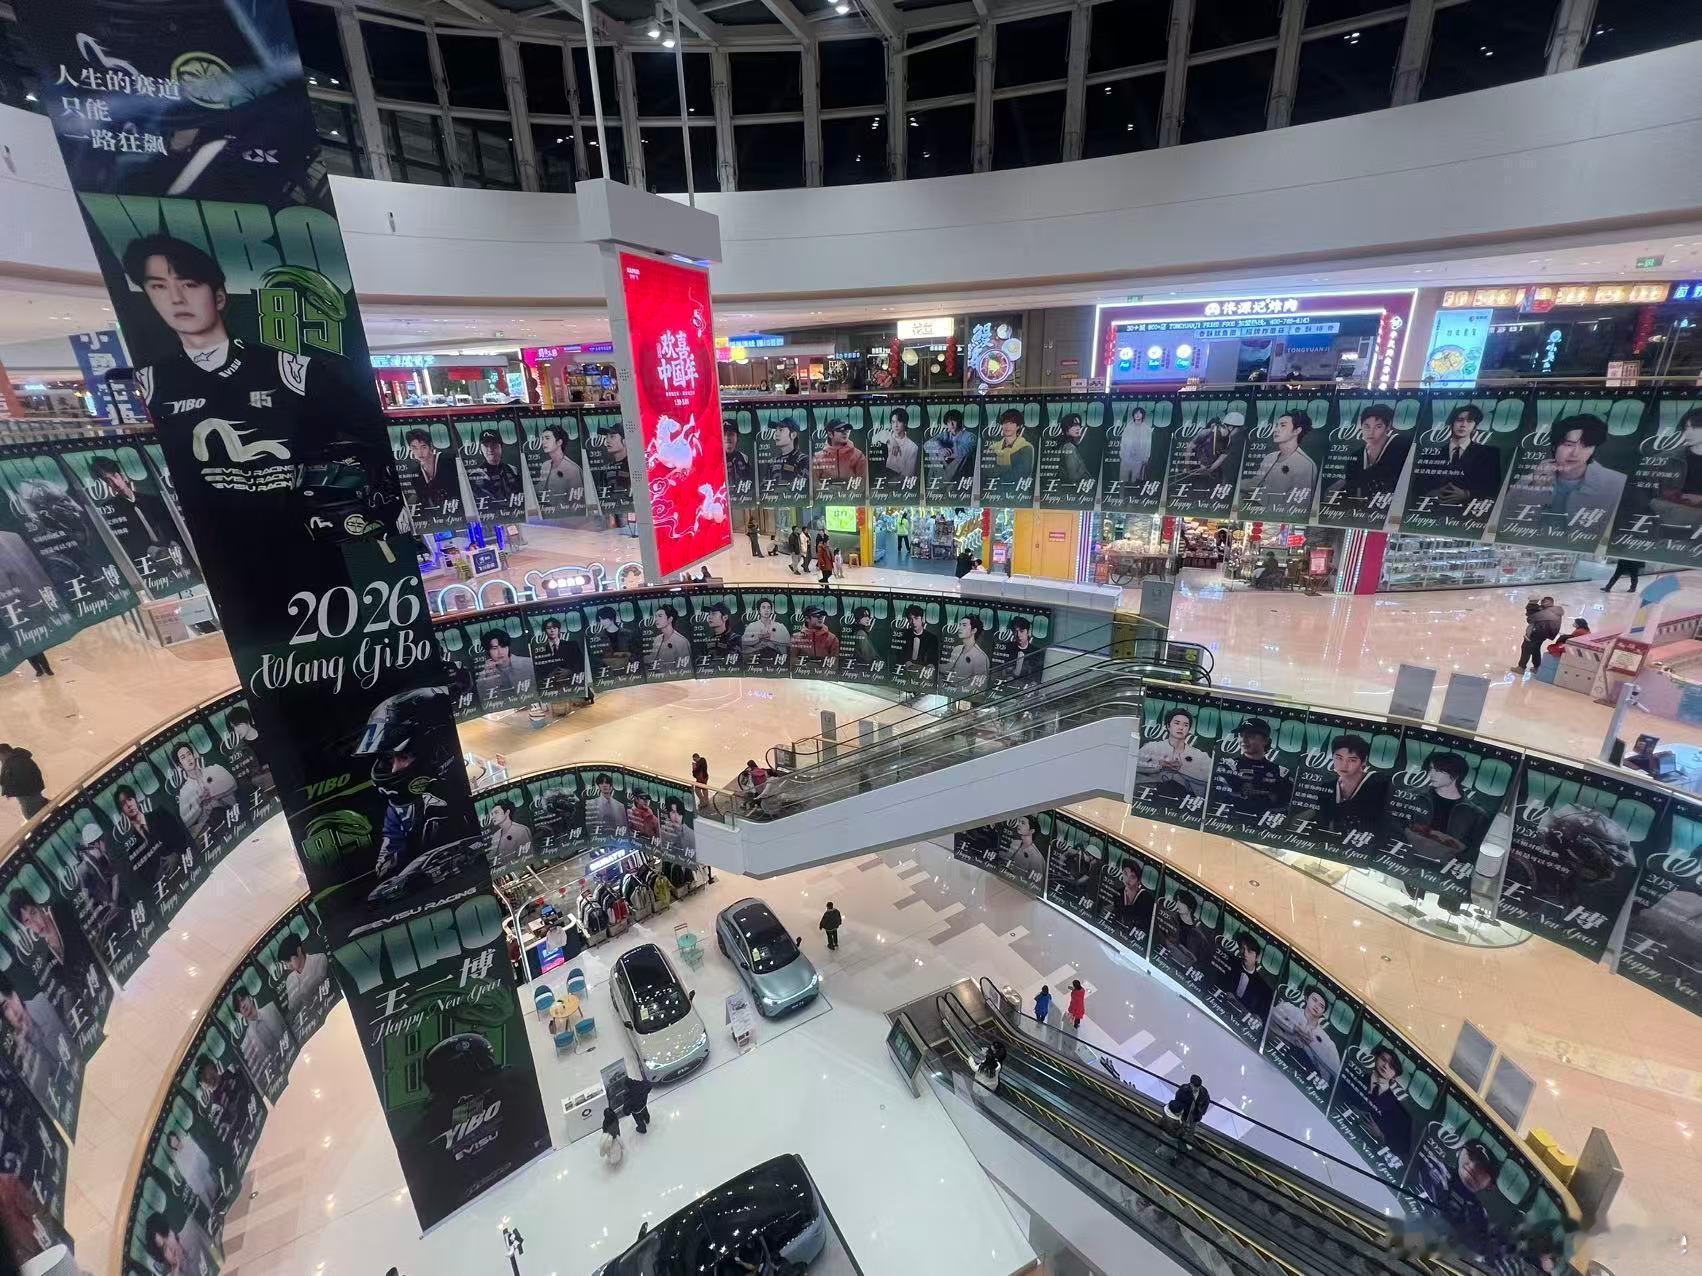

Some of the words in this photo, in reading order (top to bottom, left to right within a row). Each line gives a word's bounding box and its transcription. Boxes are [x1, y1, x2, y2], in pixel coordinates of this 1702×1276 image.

[55, 64, 181, 100] 人生的赛道
[61, 96, 112, 122] 只能
[658, 354, 698, 390] 中国年
[171, 398, 206, 414] YIBO
[763, 479, 806, 492] 王一博
[817, 477, 862, 491] 王一博
[873, 476, 917, 491] 王一博
[927, 477, 973, 491] 王一博
[984, 476, 1029, 491] 王一博
[1043, 479, 1095, 493] 王一博
[1105, 480, 1161, 495] 王一博
[1171, 484, 1232, 500] 王一博
[1244, 487, 1311, 504] 王一博
[1324, 490, 1392, 508] 王一博
[1414, 496, 1494, 516] 王一博
[1515, 504, 1606, 527] 王一博
[135, 544, 183, 577] 王一博
[64, 564, 120, 601] 王一博
[1, 585, 59, 629] 王一博
[288, 576, 419, 645] 2026
[597, 662, 640, 678] 王一博
[648, 655, 690, 671] 王一博
[697, 653, 739, 666] 王一博
[747, 655, 787, 665] 王一博
[795, 655, 836, 668] 王一博
[841, 658, 884, 672] 王一博
[250, 651, 345, 699] Wang
[541, 672, 585, 689] 王一博
[892, 664, 934, 679] 王一博
[485, 680, 530, 700] 王一博
[304, 773, 351, 799] YIBO
[1393, 789, 1416, 801] 2026
[1132, 800, 1158, 815] Happy
[1162, 807, 1178, 817] New
[1138, 786, 1204, 812] 王一博
[1205, 817, 1234, 833] Happy
[1239, 823, 1256, 834] New
[1210, 802, 1287, 829] 王一博
[201, 803, 240, 853] 王一博
[545, 826, 582, 846] 王一博
[593, 825, 627, 836] 王一博
[1286, 818, 1374, 847] 王一博
[960, 841, 997, 861] 王一博
[1284, 832, 1315, 850] Happy
[1322, 841, 1340, 852] New
[1379, 838, 1473, 880] 王一博
[153, 846, 194, 905] 王一博
[1003, 858, 1042, 884] 王一博
[1415, 869, 1438, 886] New
[423, 887, 477, 911] RACING
[1052, 884, 1093, 910] 王一博
[1502, 878, 1608, 930] 王一博
[1103, 911, 1145, 942] 王一博
[1532, 913, 1559, 930] New
[105, 900, 146, 967] 王一博
[334, 894, 502, 994] YIBO
[1158, 944, 1204, 983] 王一博
[1617, 951, 1662, 980] Happy
[370, 948, 495, 1024] 王一博
[295, 977, 331, 1032] 王一博
[1210, 984, 1262, 1033] 王一博
[370, 1010, 429, 1048] Happy
[425, 995, 464, 1020] New
[1268, 1038, 1330, 1091] 王一博
[438, 1100, 501, 1150] YIBO
[1335, 1102, 1405, 1171] 王一博
